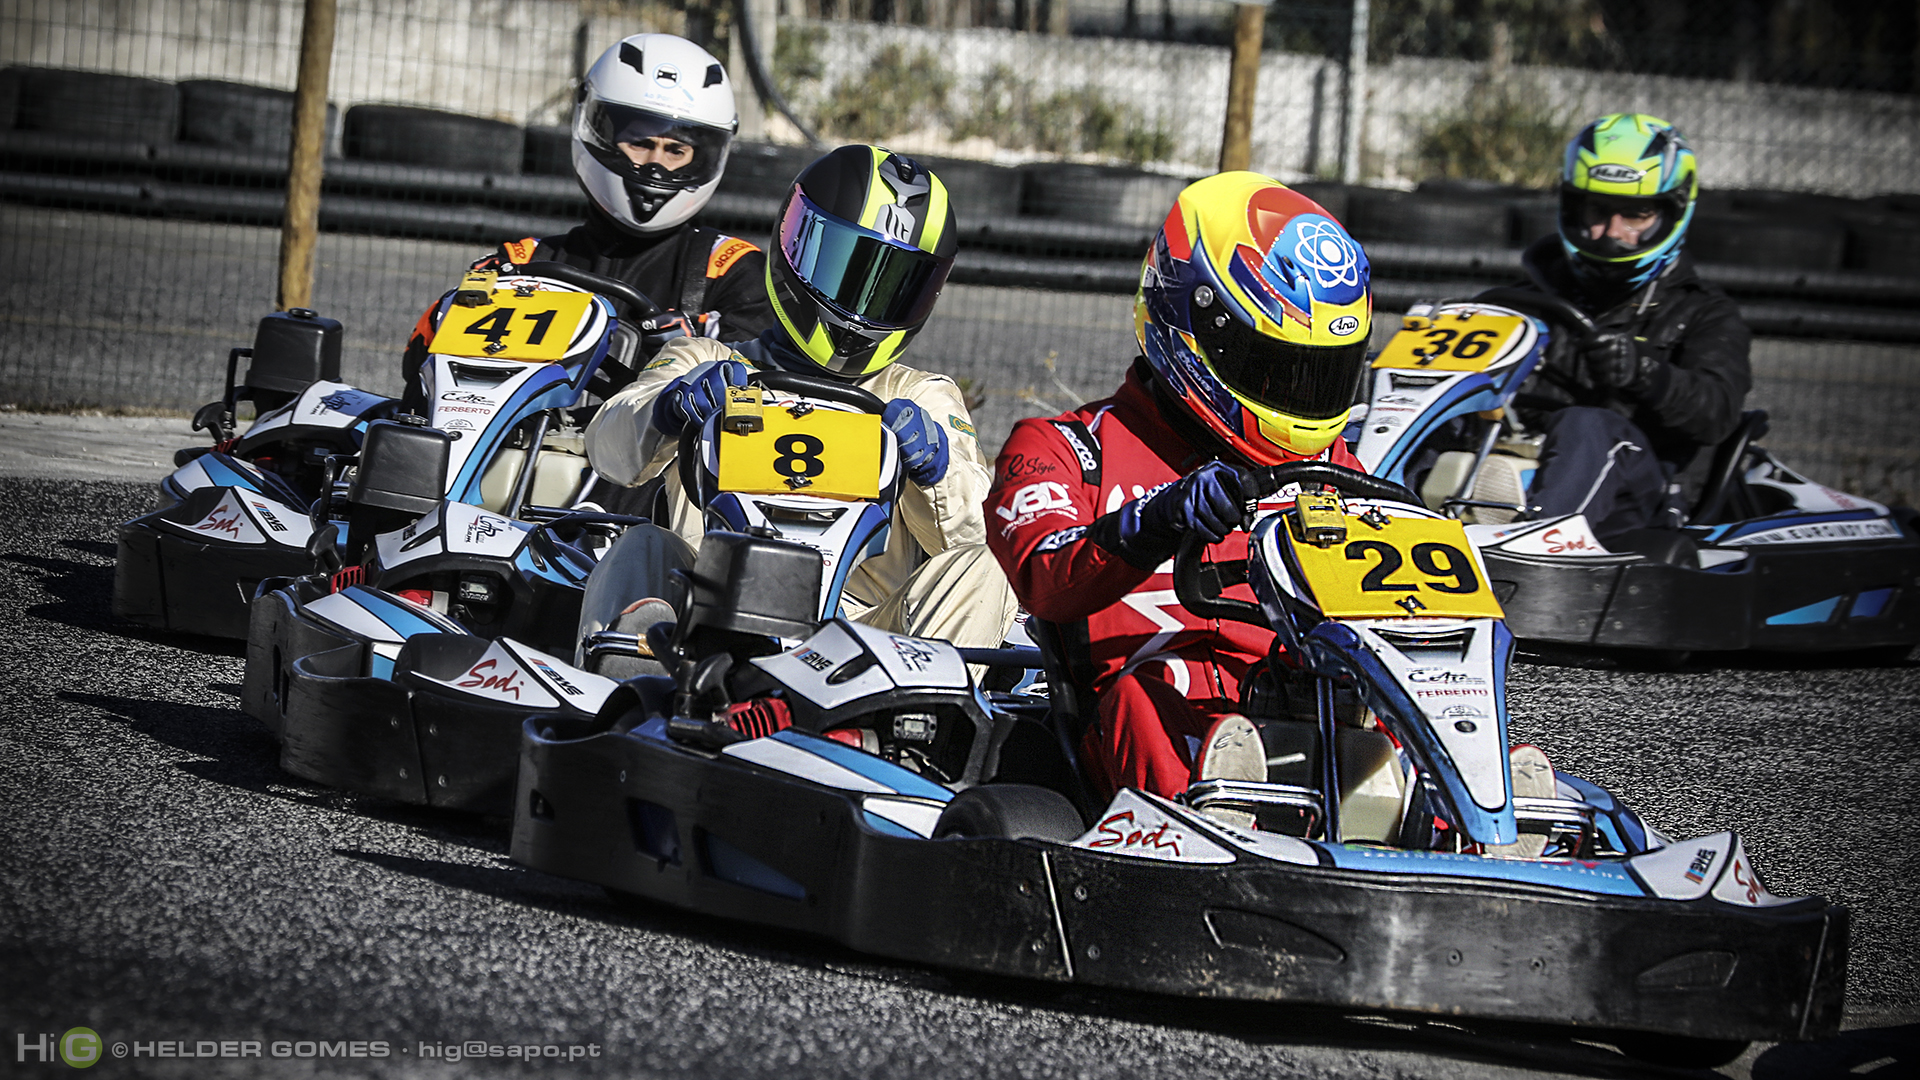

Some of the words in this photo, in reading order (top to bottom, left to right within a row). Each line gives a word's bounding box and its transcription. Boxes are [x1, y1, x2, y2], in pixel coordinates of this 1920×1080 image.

[464, 307, 558, 345] 41
[1332, 317, 1356, 331] Arai
[1412, 329, 1498, 359] 36
[438, 405, 491, 415] FERBERTO
[773, 433, 825, 478] 8
[1054, 422, 1098, 471] sparco
[1024, 457, 1056, 476] Style
[197, 504, 243, 540] Sodi
[1344, 540, 1479, 594] 29
[457, 658, 524, 701] Sodi
[1089, 809, 1182, 857] Sodi
